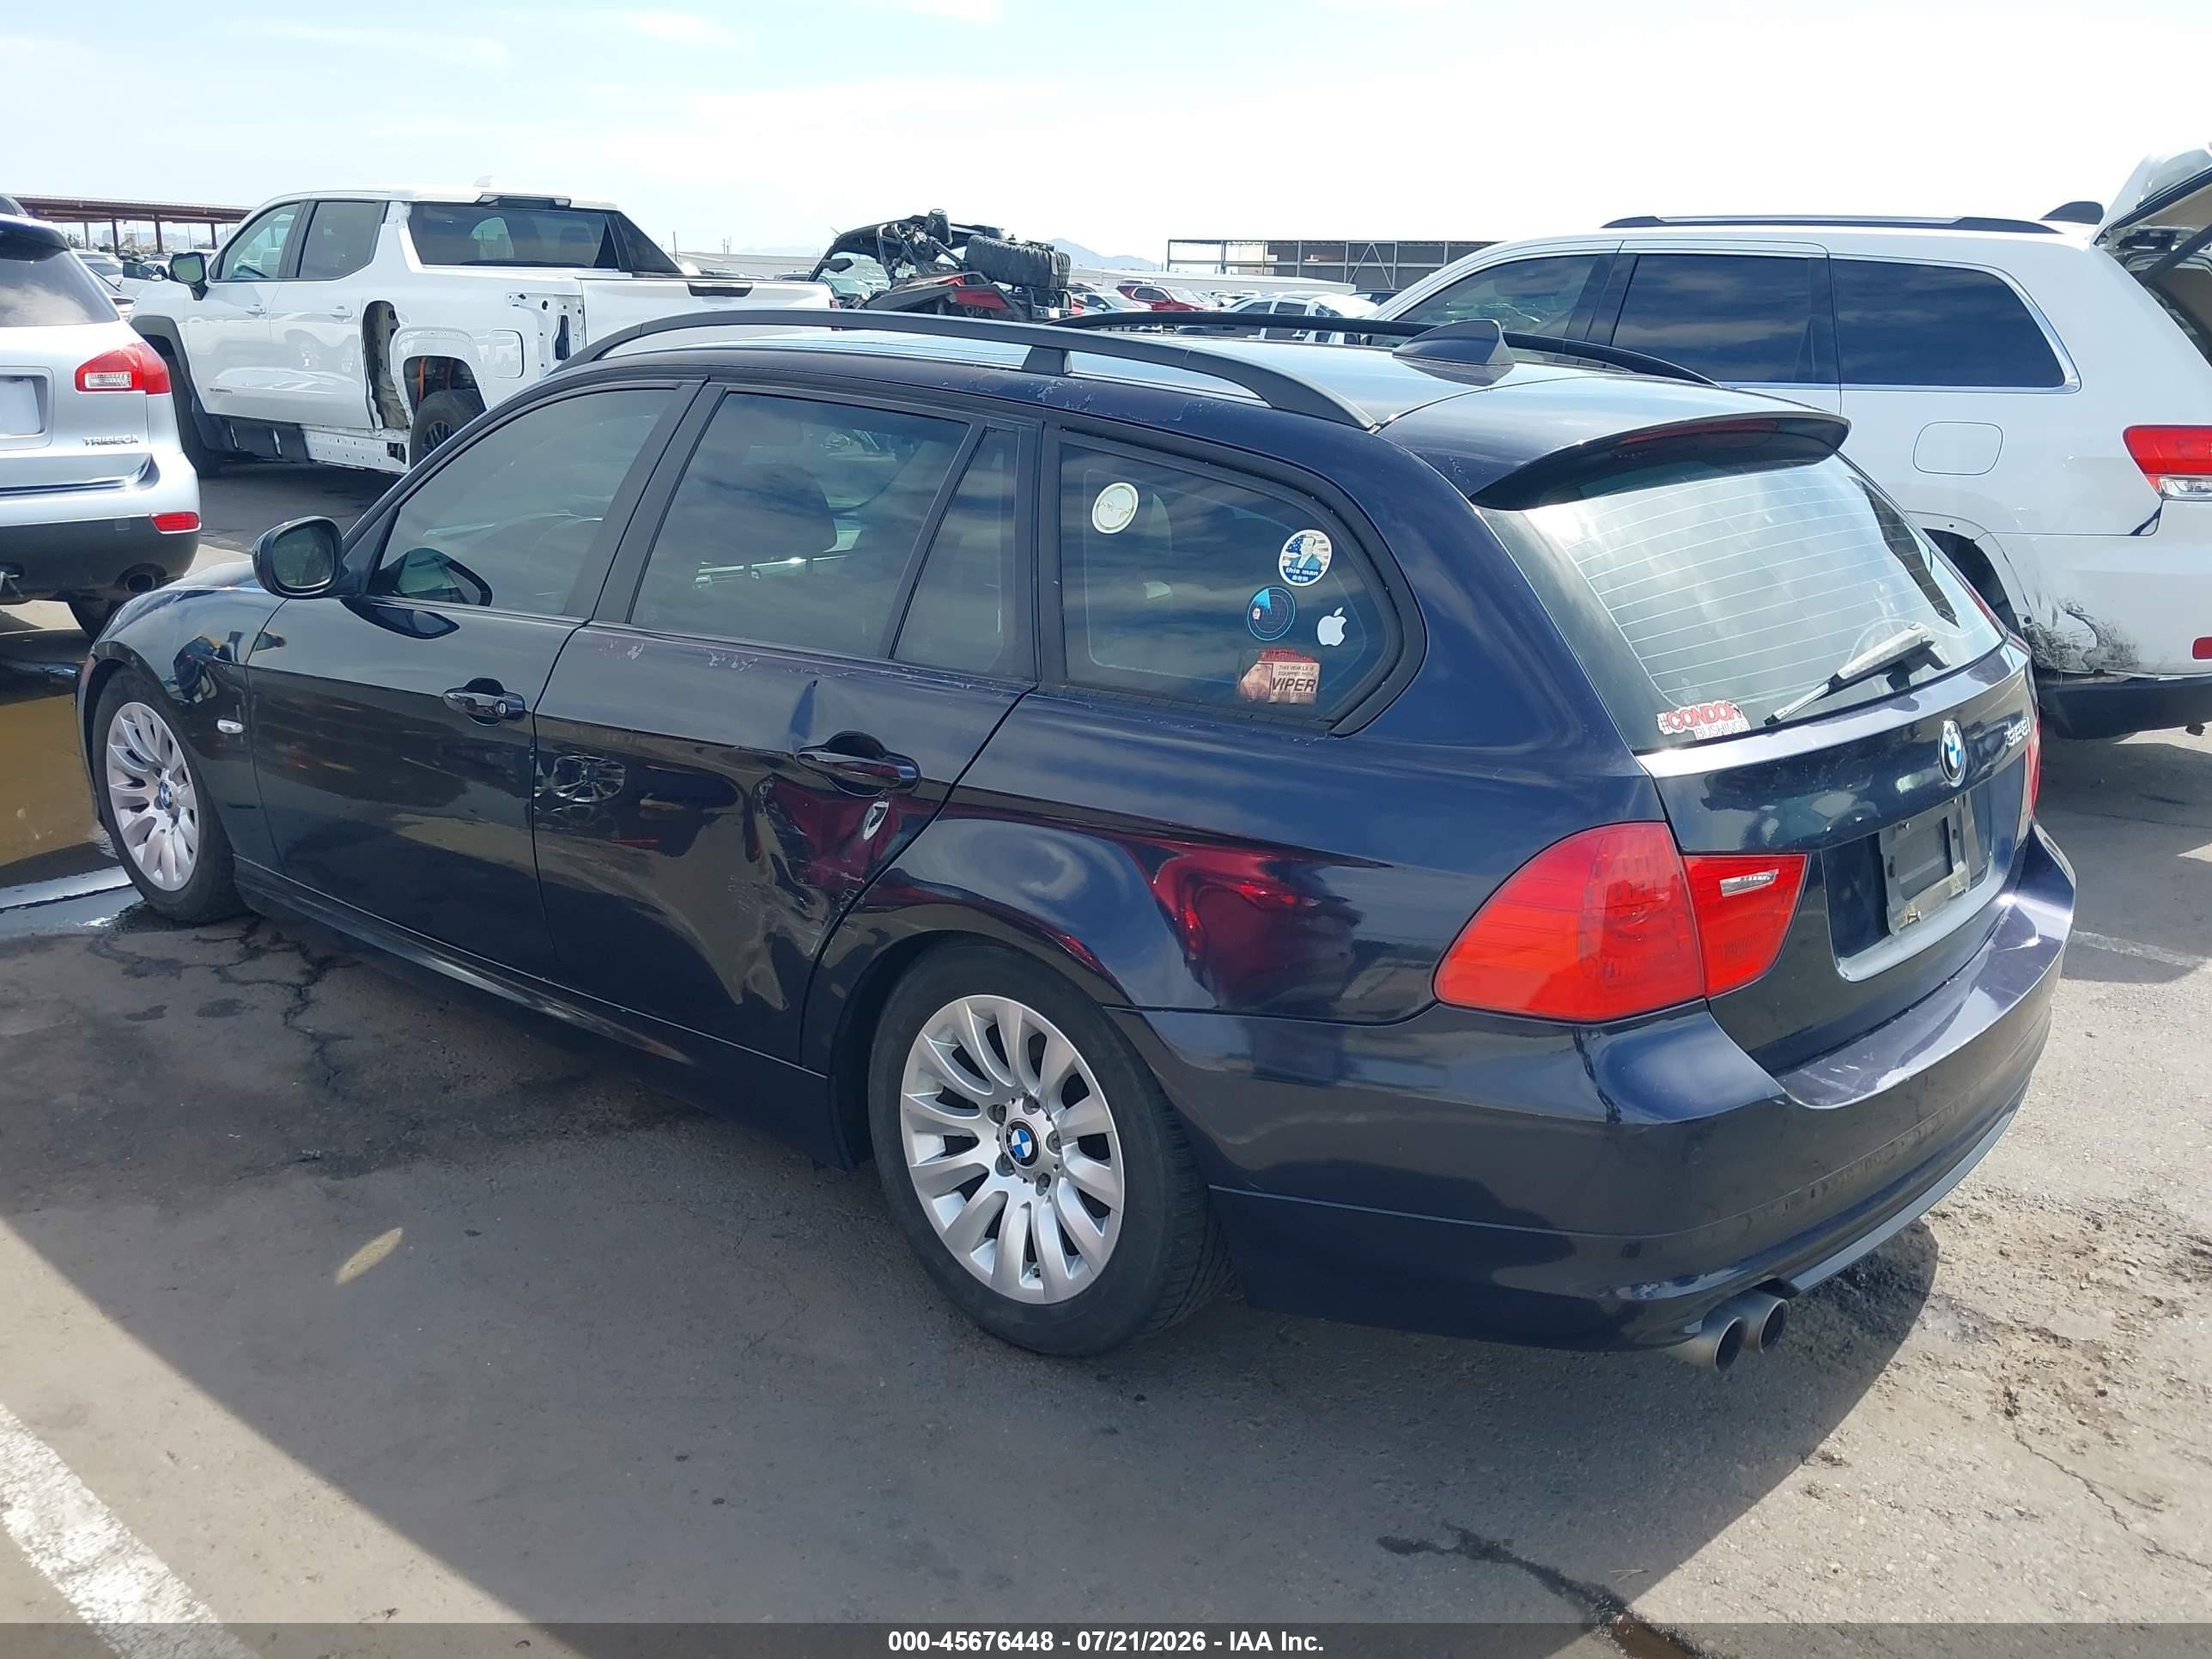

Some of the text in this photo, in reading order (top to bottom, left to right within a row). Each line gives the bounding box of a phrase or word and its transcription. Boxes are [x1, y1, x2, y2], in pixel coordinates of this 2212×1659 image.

[82, 434, 139, 446] TRIBECA
[1273, 677, 1316, 692] VIPER
[1695, 720, 1750, 739] BUSHINGS
